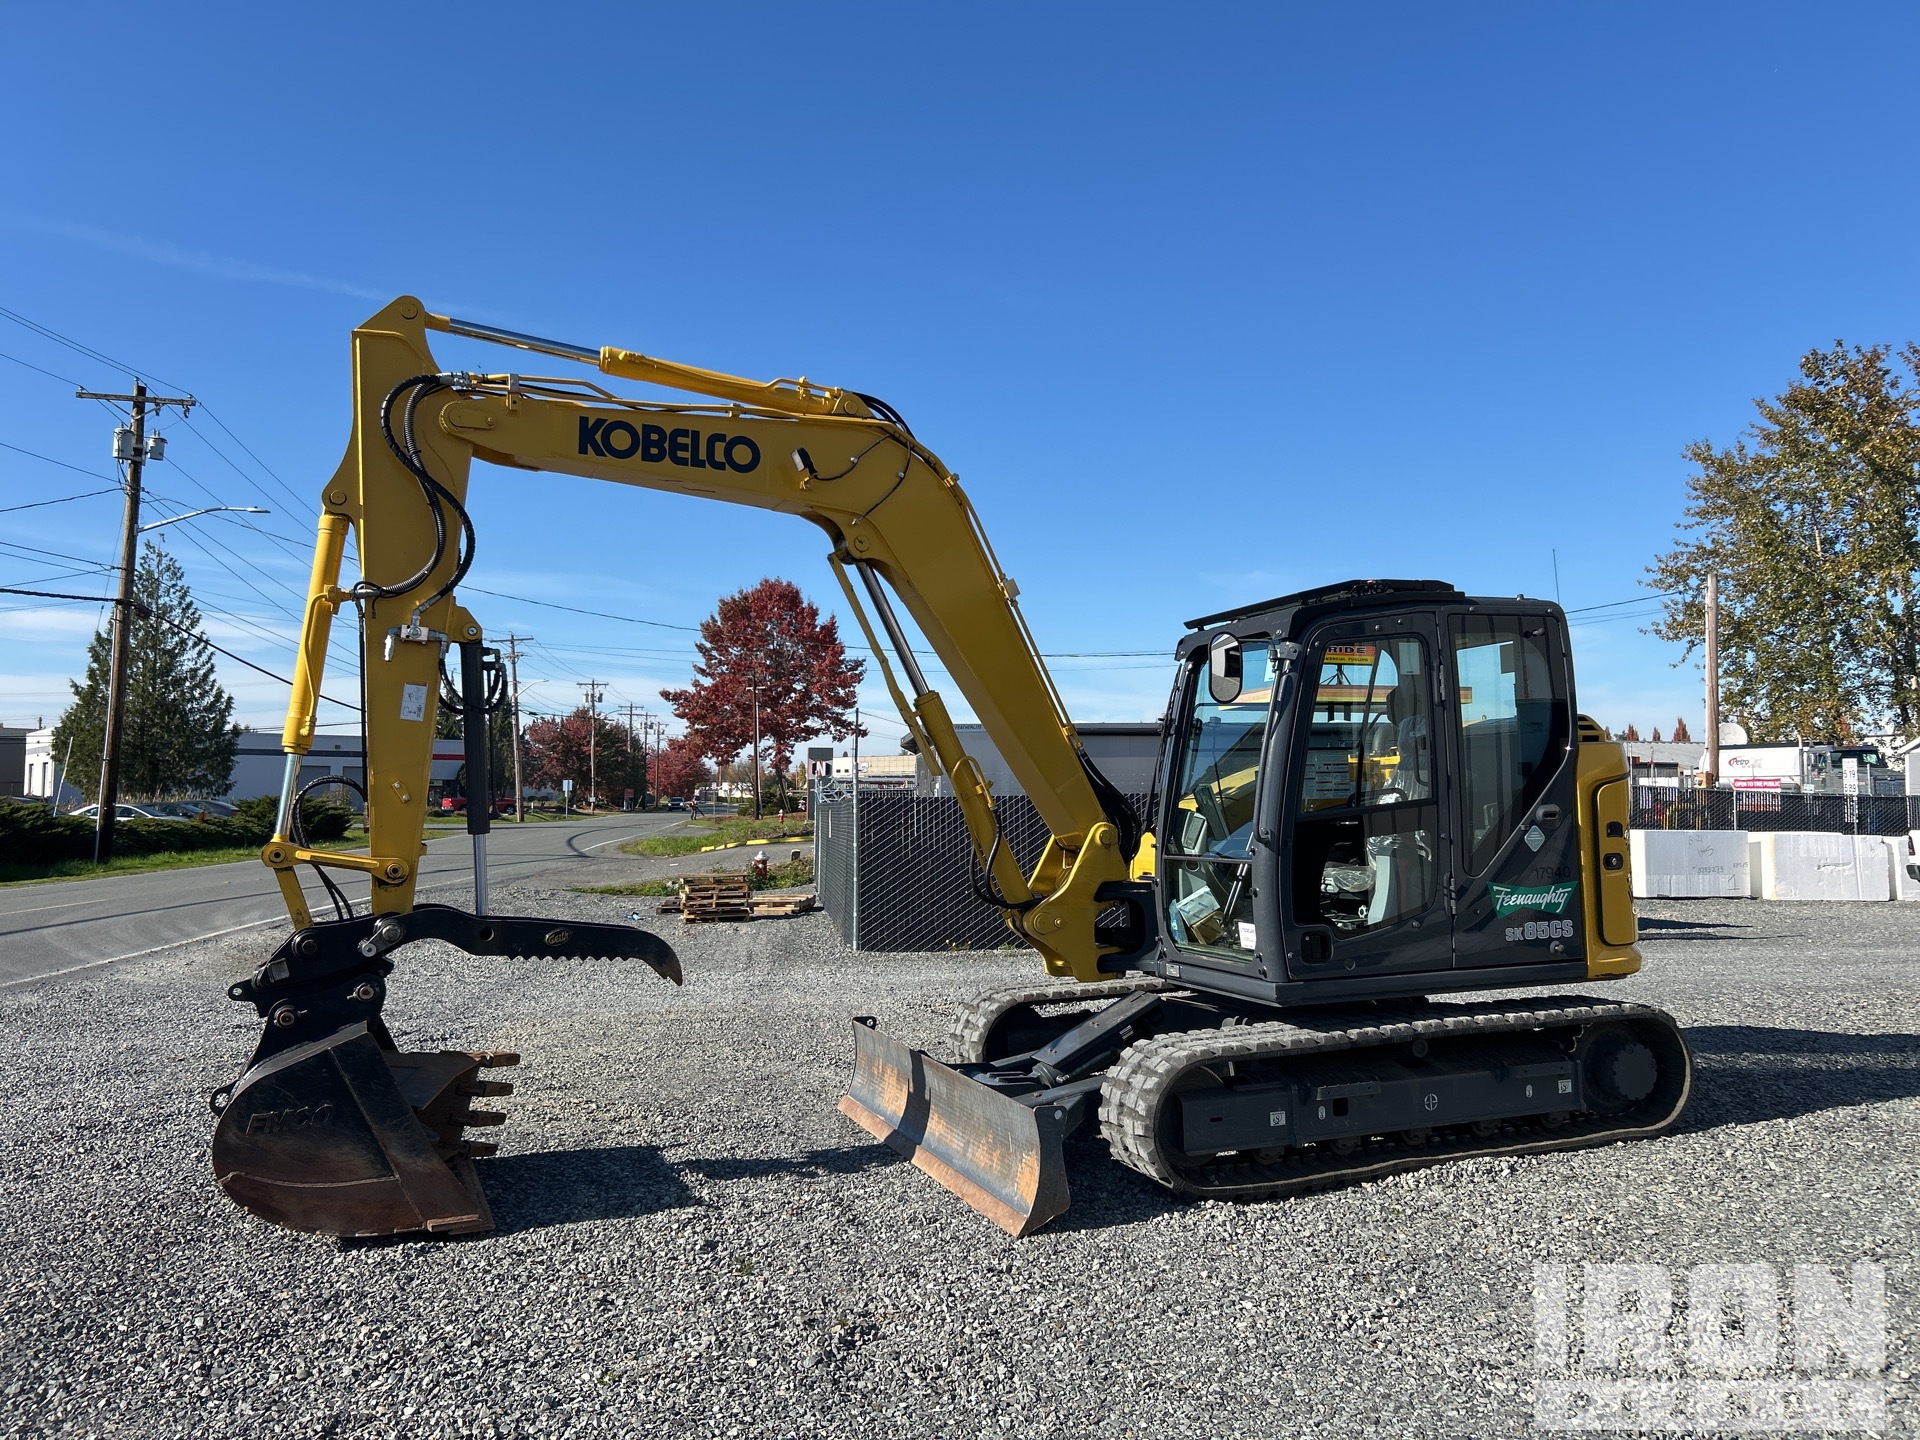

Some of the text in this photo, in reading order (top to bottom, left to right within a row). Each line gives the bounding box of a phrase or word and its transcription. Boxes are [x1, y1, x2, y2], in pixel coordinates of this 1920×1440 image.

[578, 415, 761, 474] KOBELCO
[1328, 645, 1367, 655] RIDE
[1533, 865, 1571, 879] 17940
[1492, 885, 1572, 913] Feenaughty
